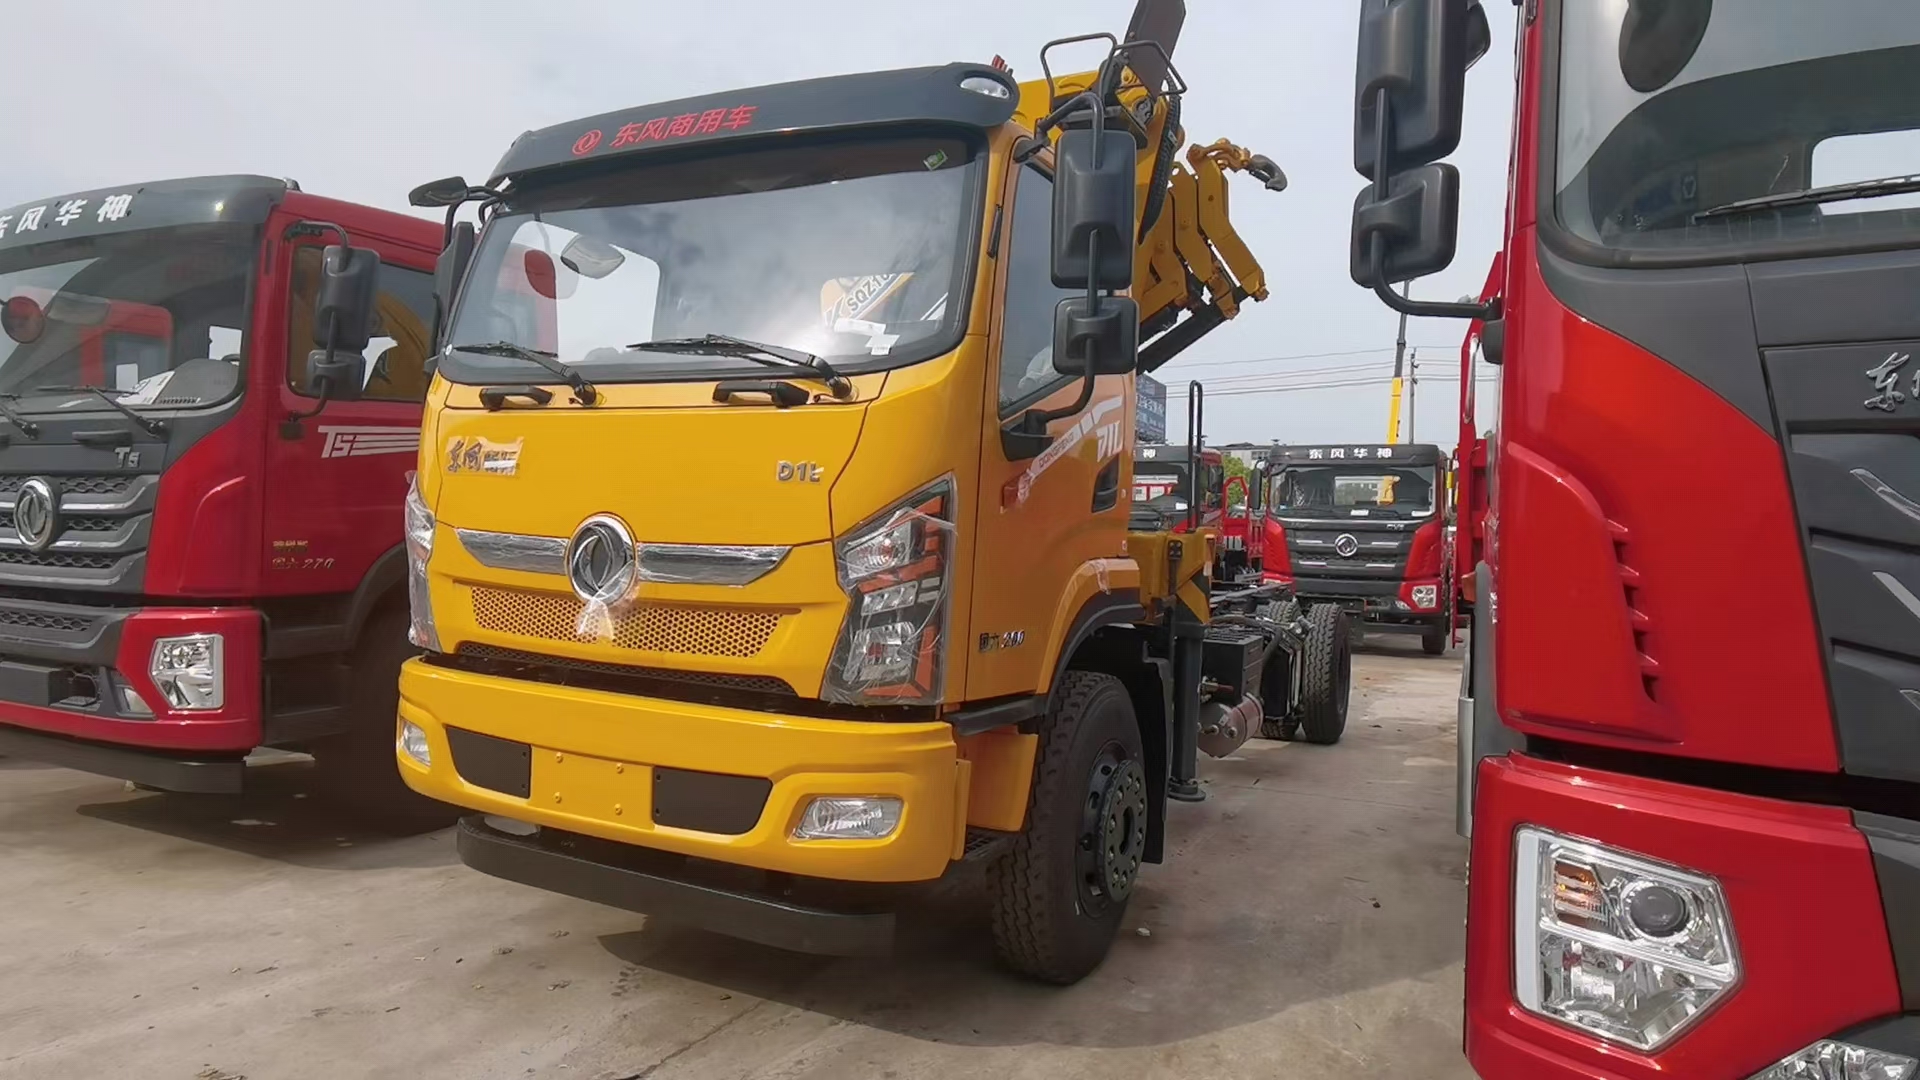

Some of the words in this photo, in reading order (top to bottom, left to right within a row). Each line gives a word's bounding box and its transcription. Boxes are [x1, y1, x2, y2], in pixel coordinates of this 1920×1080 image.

[610, 104, 759, 147] 东风商用车
[1309, 447, 1393, 460] 东风华神
